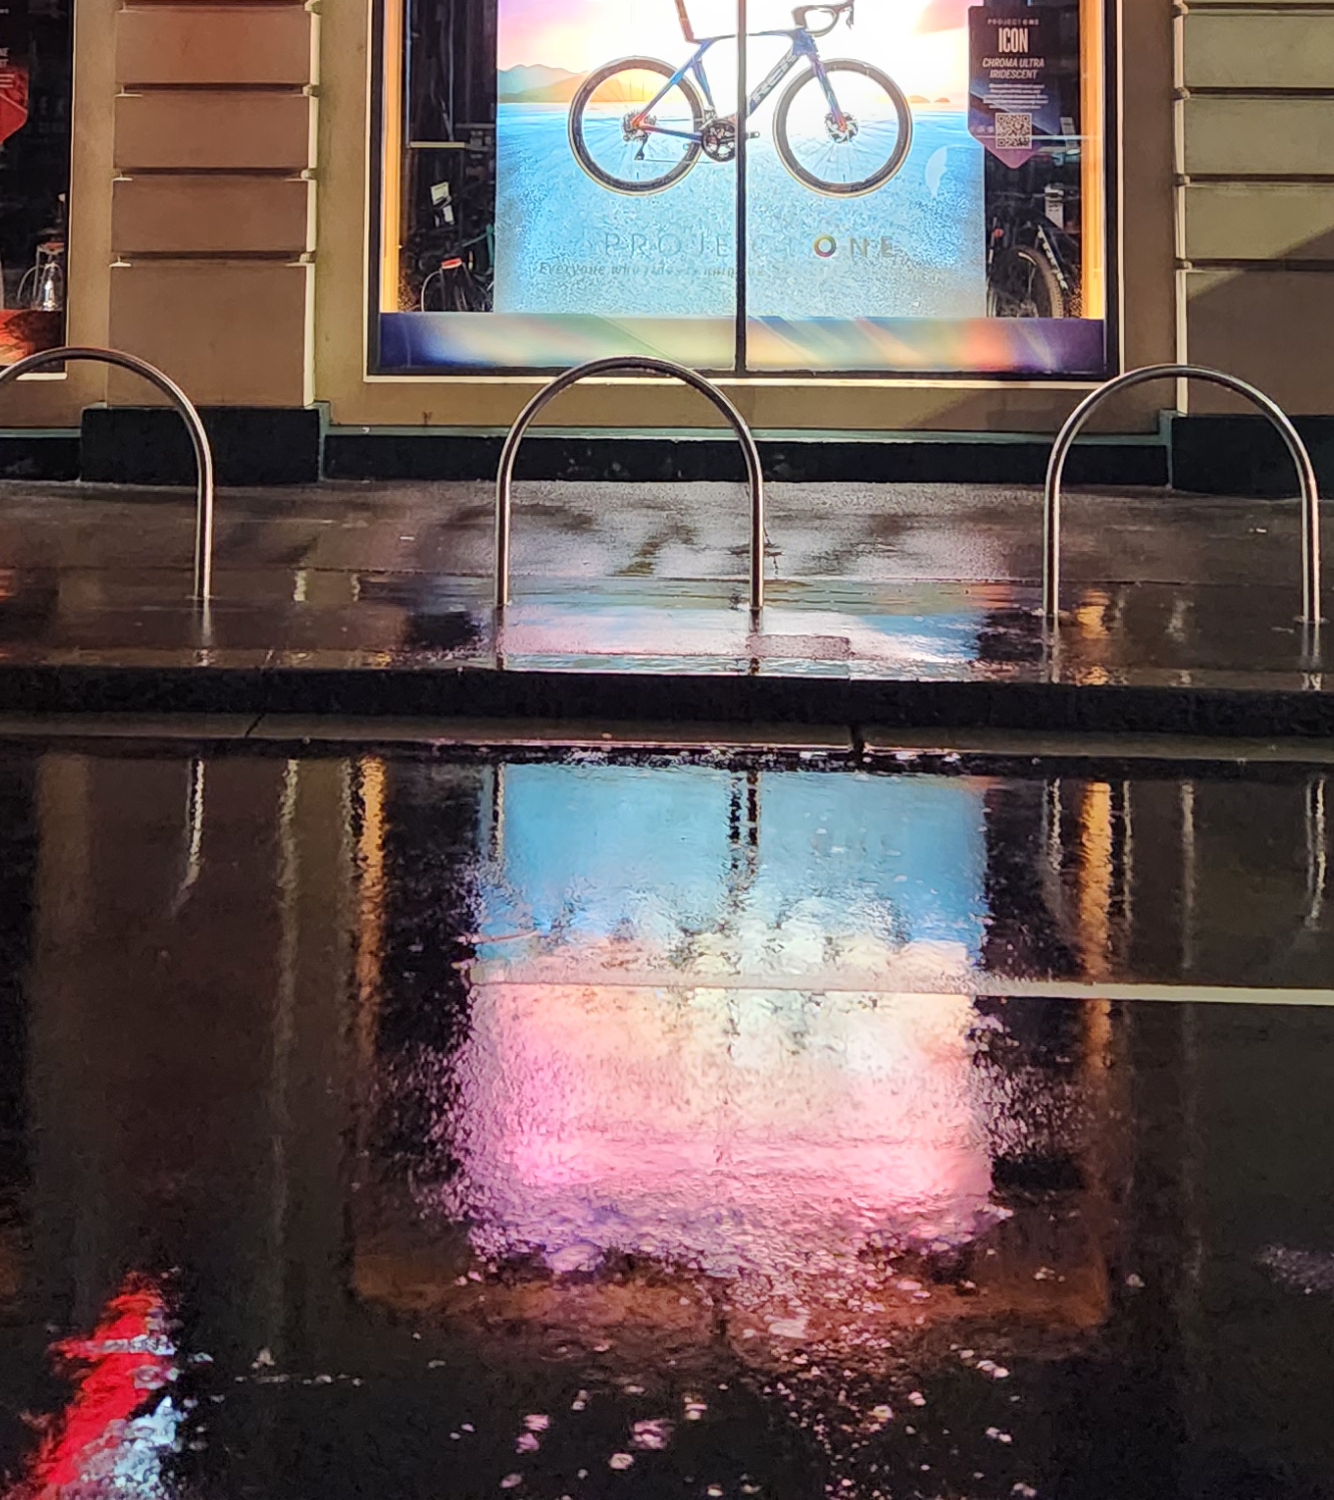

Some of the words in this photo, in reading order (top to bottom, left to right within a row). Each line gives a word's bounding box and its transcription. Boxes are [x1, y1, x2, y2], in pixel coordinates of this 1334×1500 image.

[998, 28, 1029, 53] ICON
[982, 58, 1018, 68] CHROMA
[1019, 58, 1045, 68] ULTRA
[989, 69, 1038, 79] IRIDESCENT
[750, 54, 799, 105] REK
[812, 233, 894, 259] ONE
